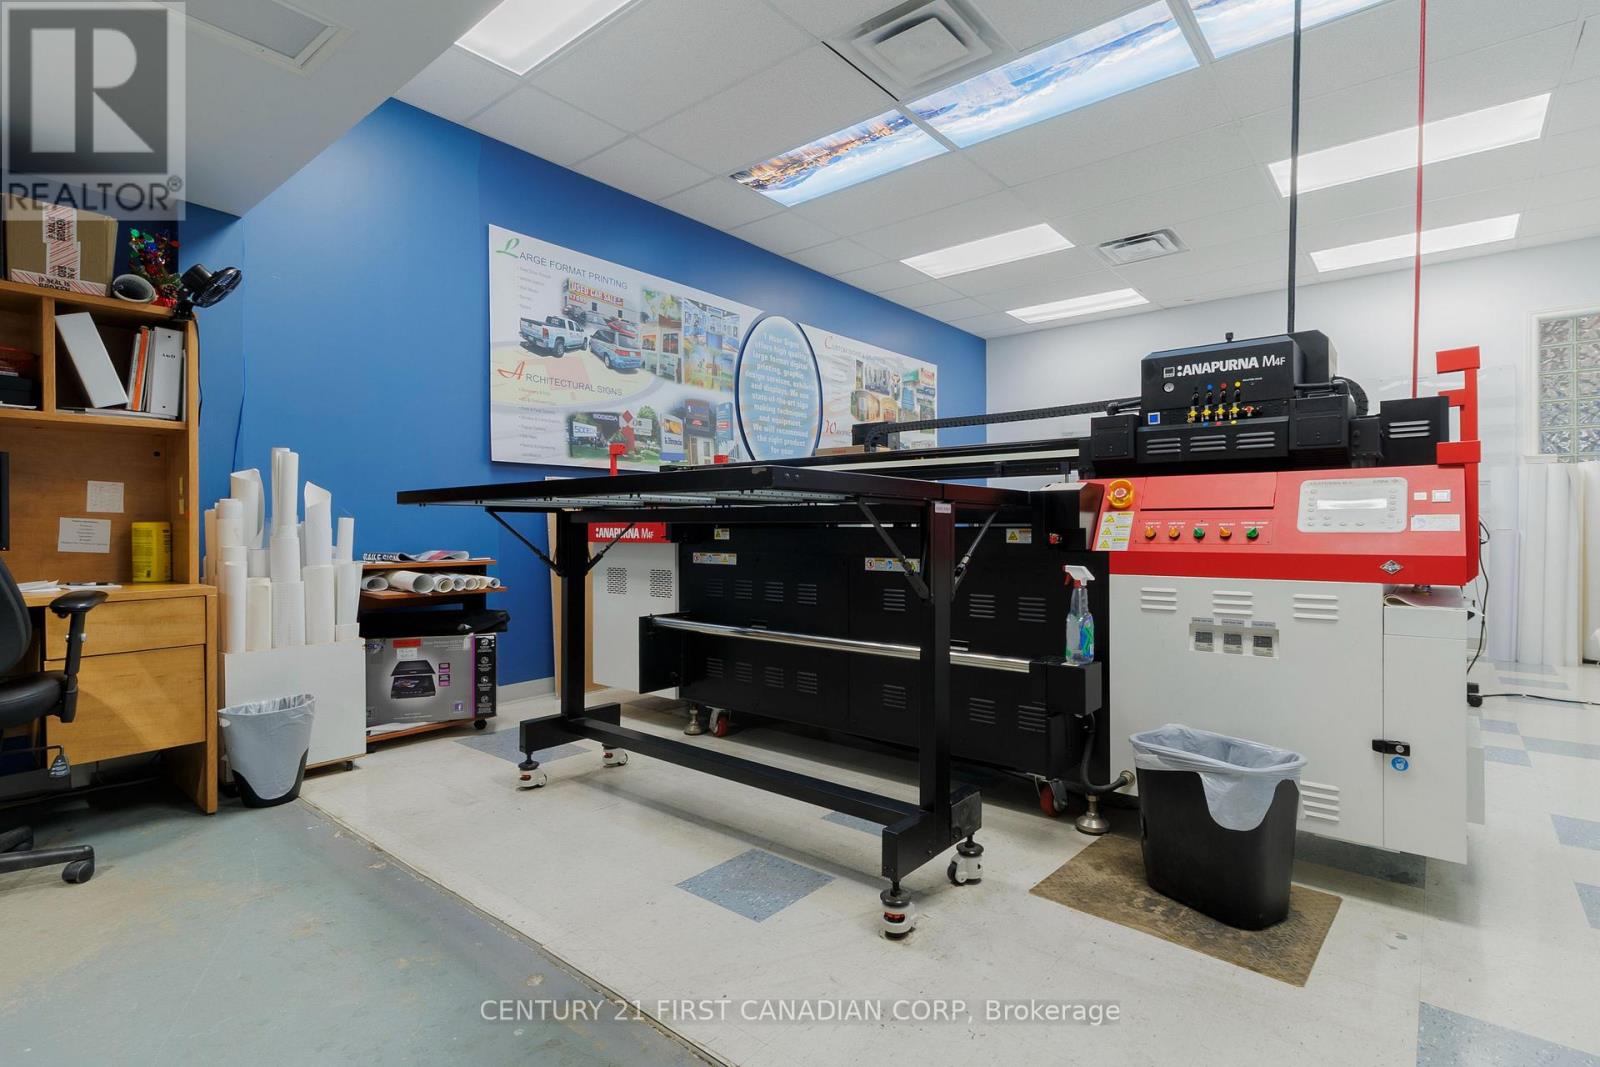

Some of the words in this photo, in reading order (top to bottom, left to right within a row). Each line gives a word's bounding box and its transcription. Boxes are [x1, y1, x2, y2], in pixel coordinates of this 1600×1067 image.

[549, 260, 586, 278] FORMAT
[588, 270, 628, 290] PRINTING
[597, 385, 622, 396] SIGNS
